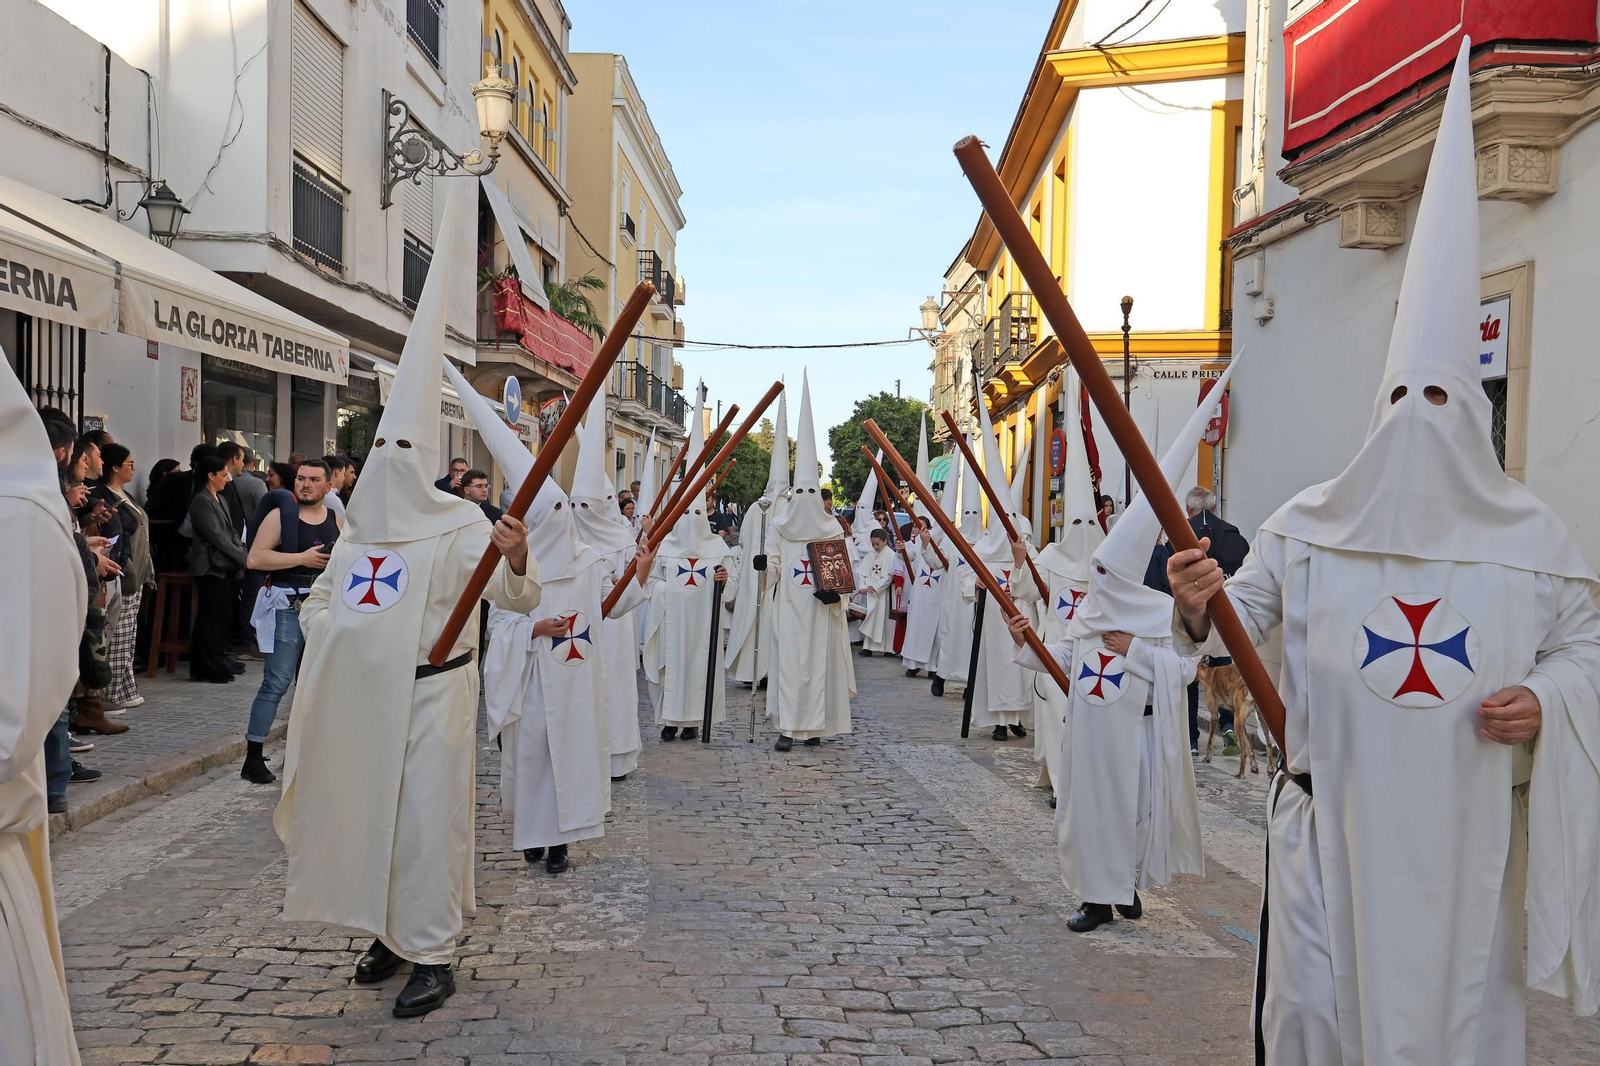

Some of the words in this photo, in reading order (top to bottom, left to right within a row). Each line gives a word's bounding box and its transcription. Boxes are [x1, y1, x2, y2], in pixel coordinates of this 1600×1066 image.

[154, 300, 183, 334] LA
[186, 311, 259, 354] GLORIA
[262, 332, 336, 373] TABERNA
[1153, 370, 1188, 379] CALLE
